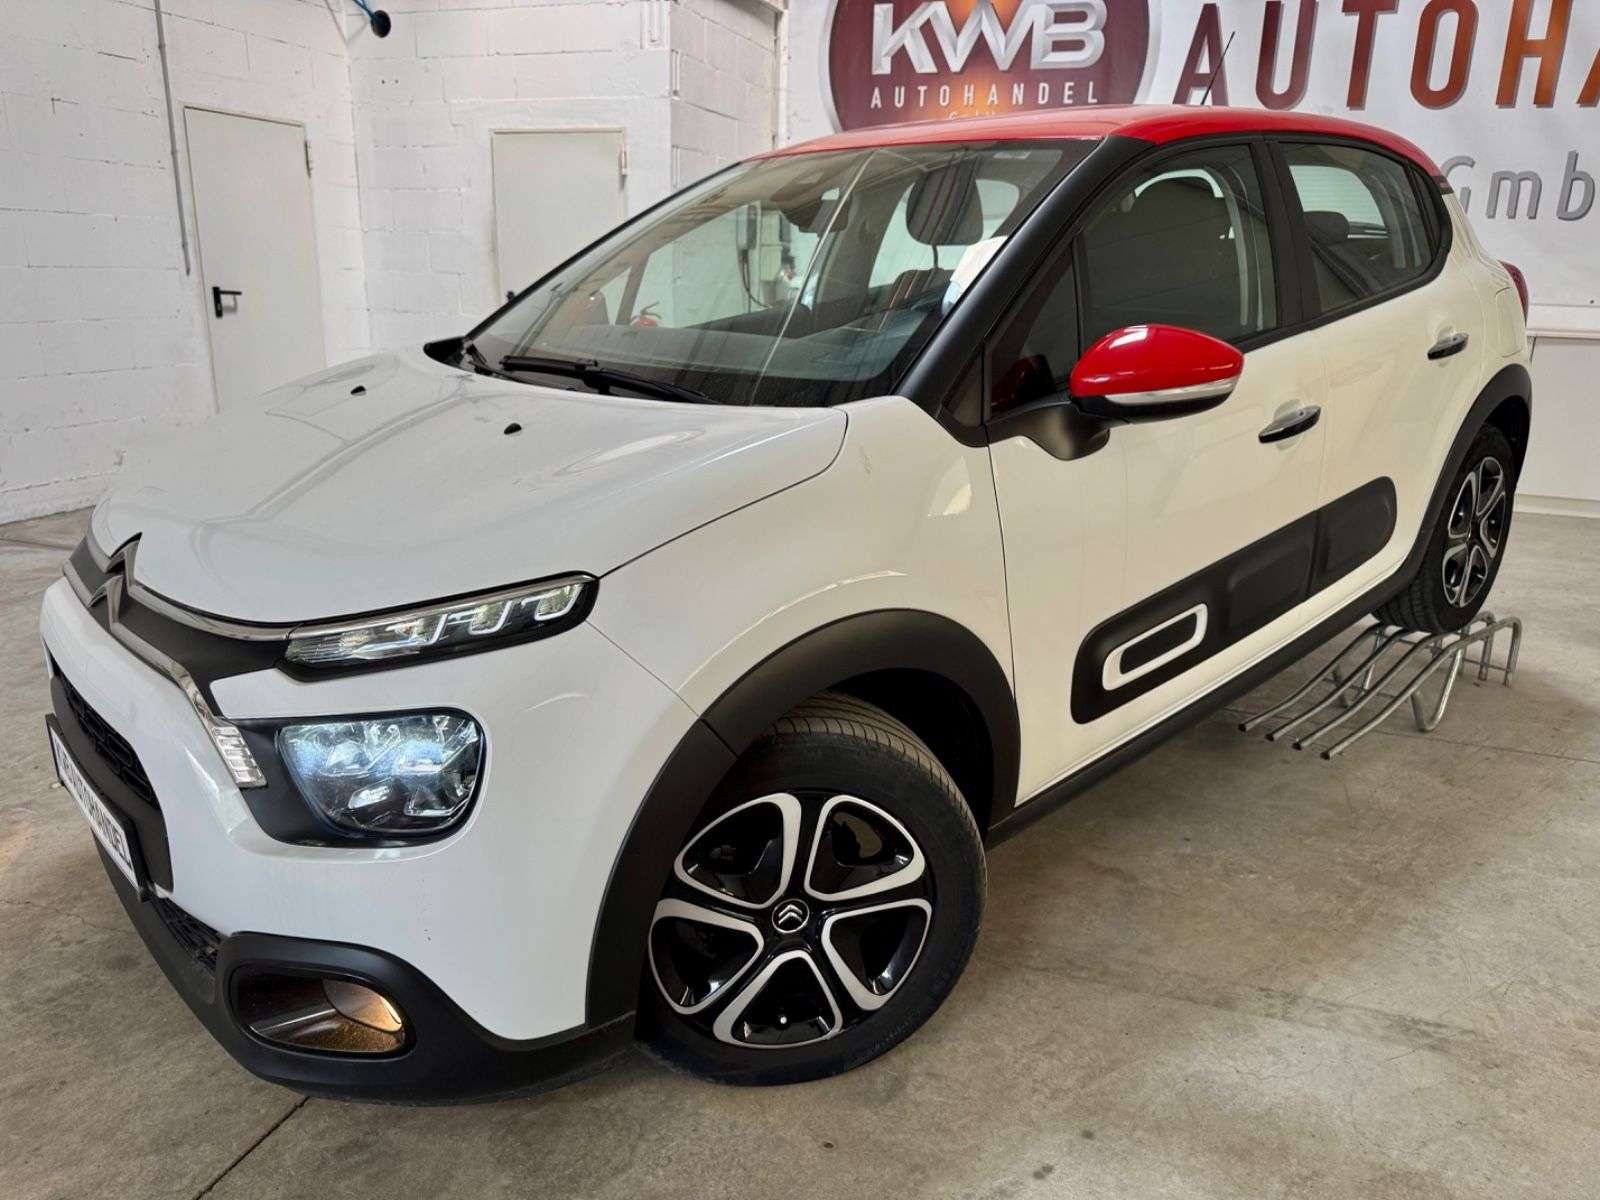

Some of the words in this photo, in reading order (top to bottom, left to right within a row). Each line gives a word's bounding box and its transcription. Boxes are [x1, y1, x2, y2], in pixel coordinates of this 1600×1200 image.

[871, 0, 1108, 75] KWB
[1172, 0, 1600, 111] AUTOH
[870, 81, 1099, 109] AUTOHANDEL
